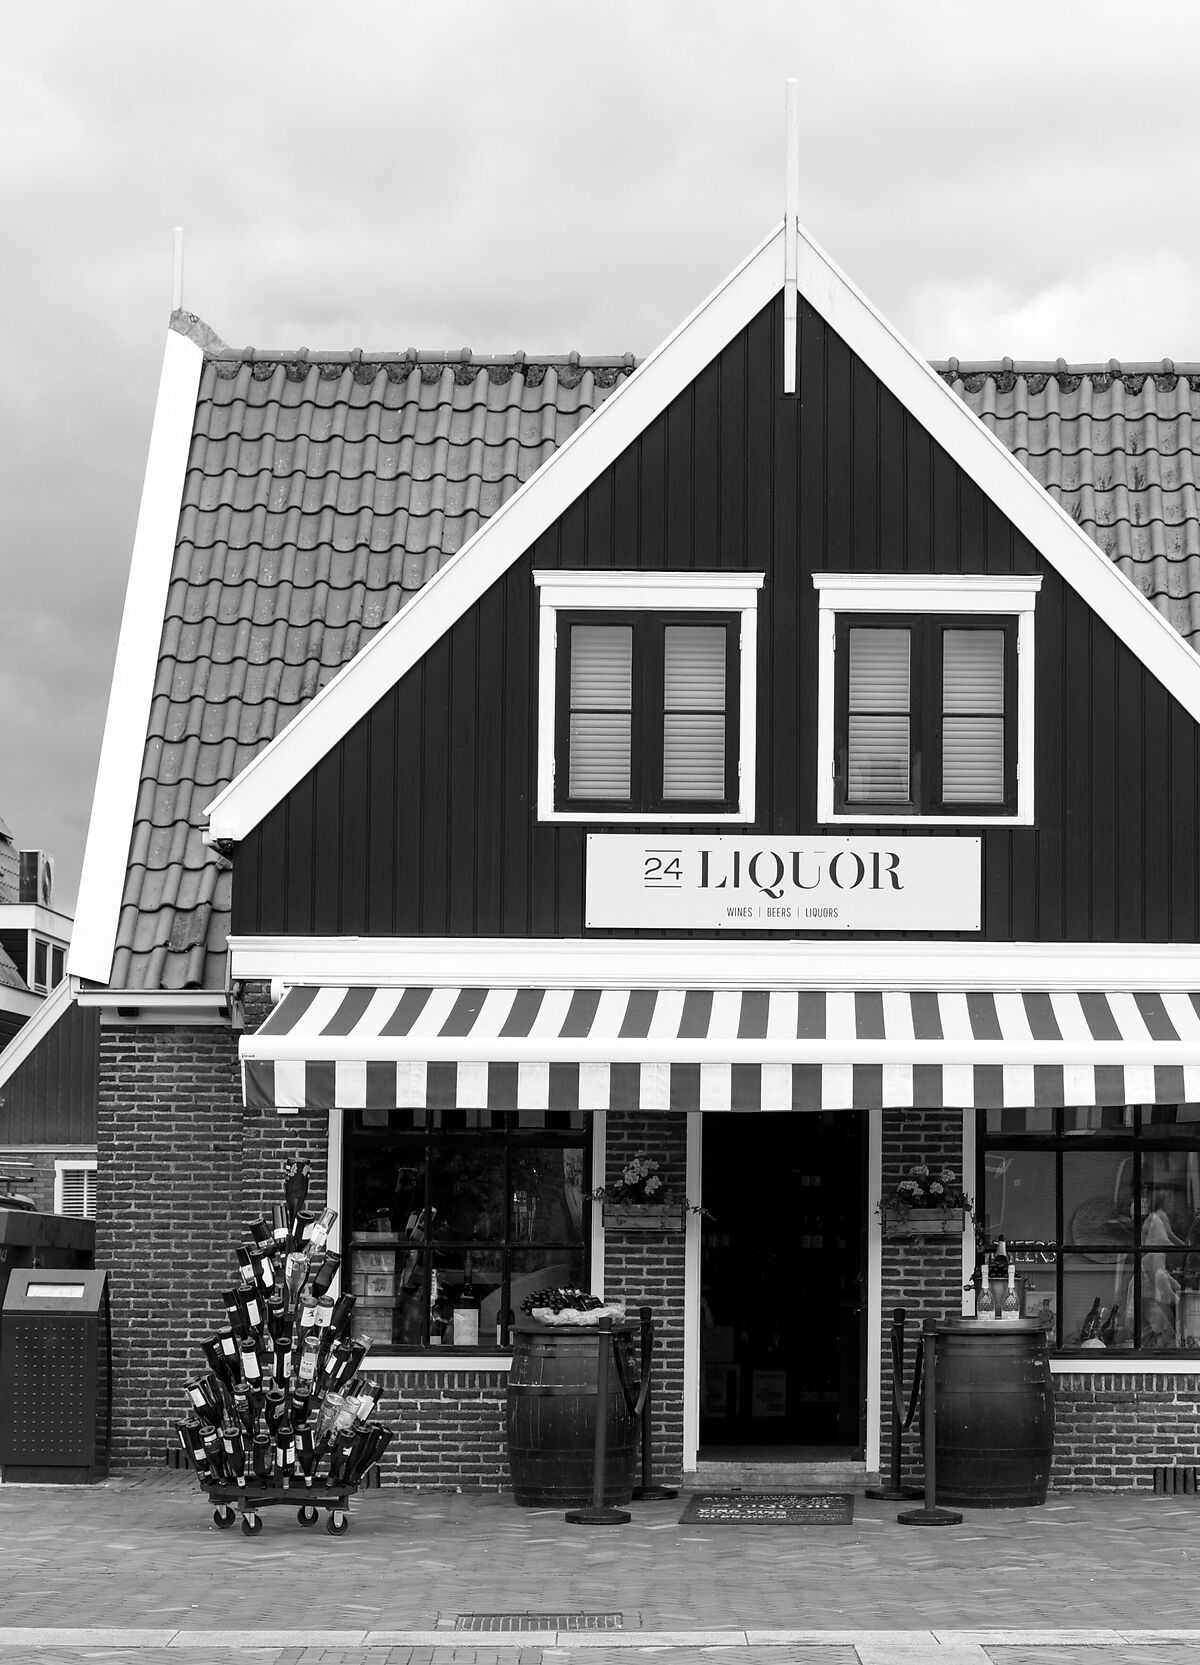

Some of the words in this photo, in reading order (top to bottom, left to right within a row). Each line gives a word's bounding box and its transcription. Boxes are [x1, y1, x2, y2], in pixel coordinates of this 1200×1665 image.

[644, 856, 683, 881] 24
[698, 850, 904, 899] LIQUOR
[726, 906, 753, 918] WINES
[766, 906, 792, 919] BEERS
[805, 906, 839, 919] LIQUORS
